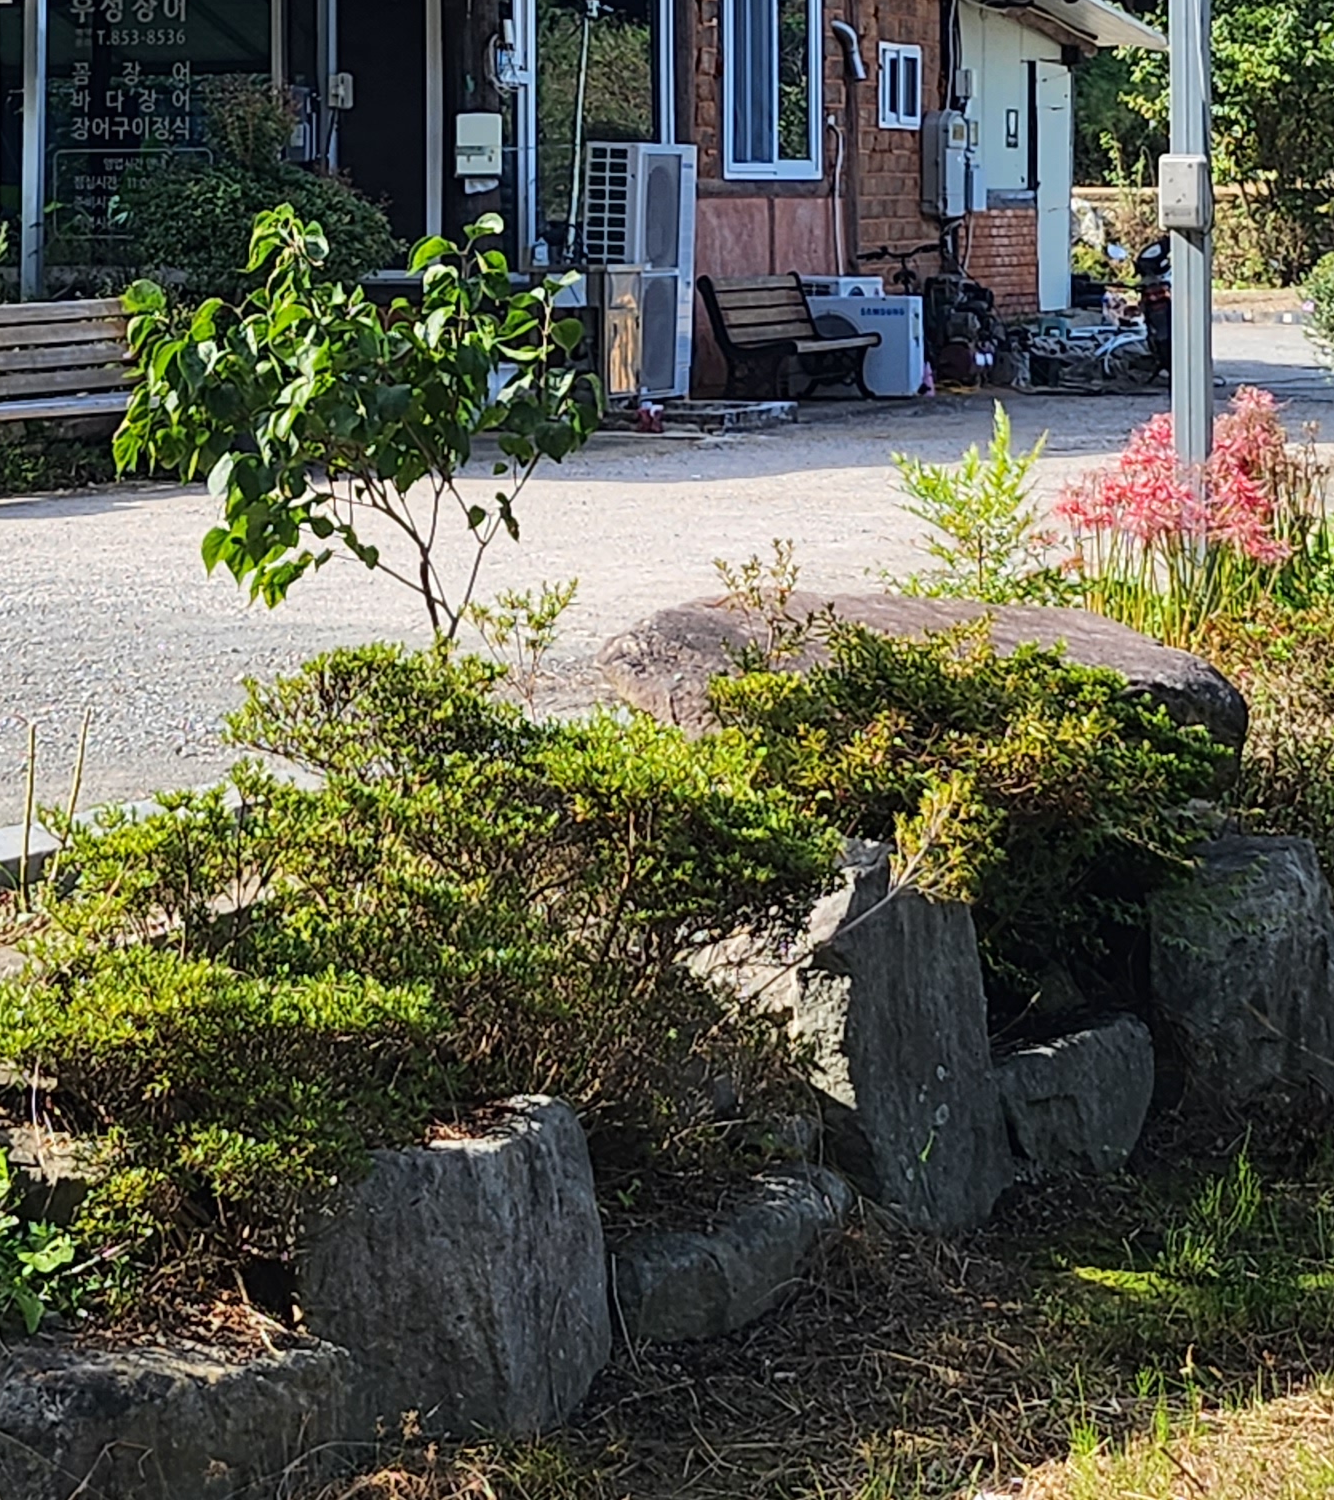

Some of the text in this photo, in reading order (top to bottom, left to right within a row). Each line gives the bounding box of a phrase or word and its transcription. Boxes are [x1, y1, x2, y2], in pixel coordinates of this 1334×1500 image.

[95, 28, 186, 46] T.853-8536
[70, 115, 191, 141] 장어구이정식
[860, 307, 905, 317] SAMSUNG
